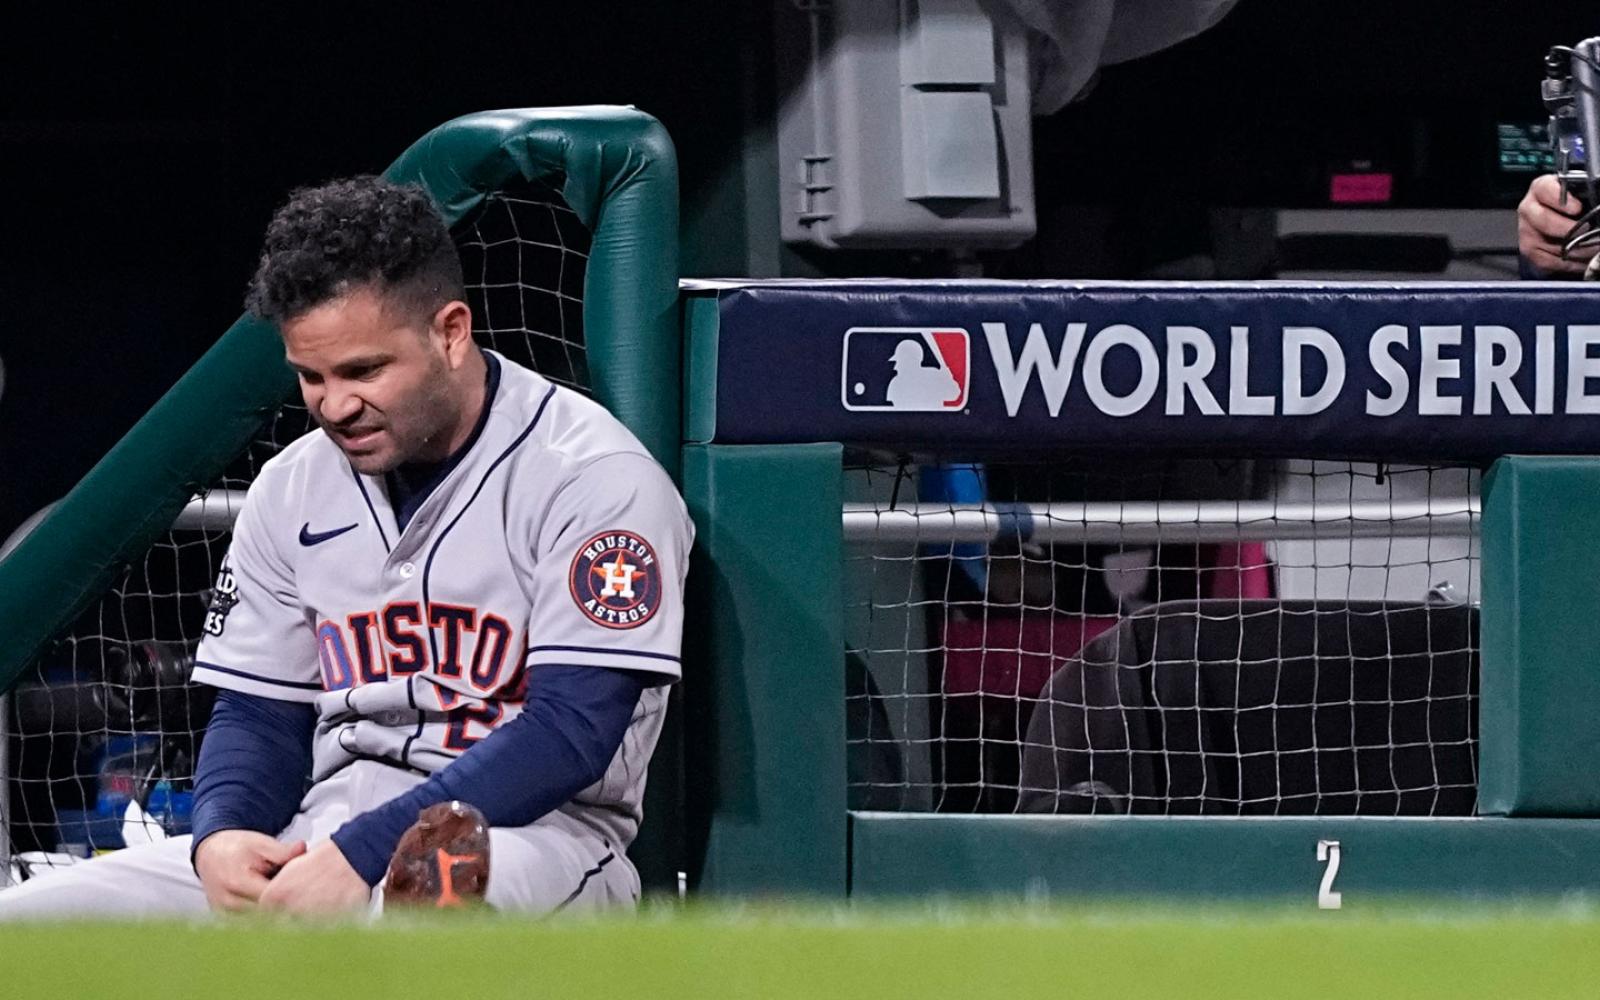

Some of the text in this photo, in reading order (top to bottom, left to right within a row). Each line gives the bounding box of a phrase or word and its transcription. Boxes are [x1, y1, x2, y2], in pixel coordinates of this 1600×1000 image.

[981, 322, 1347, 417] WORLD
[583, 535, 654, 566] HOUSTON
[601, 562, 637, 598] H
[584, 598, 649, 623] ASTROS
[1317, 840, 1341, 909] 2
